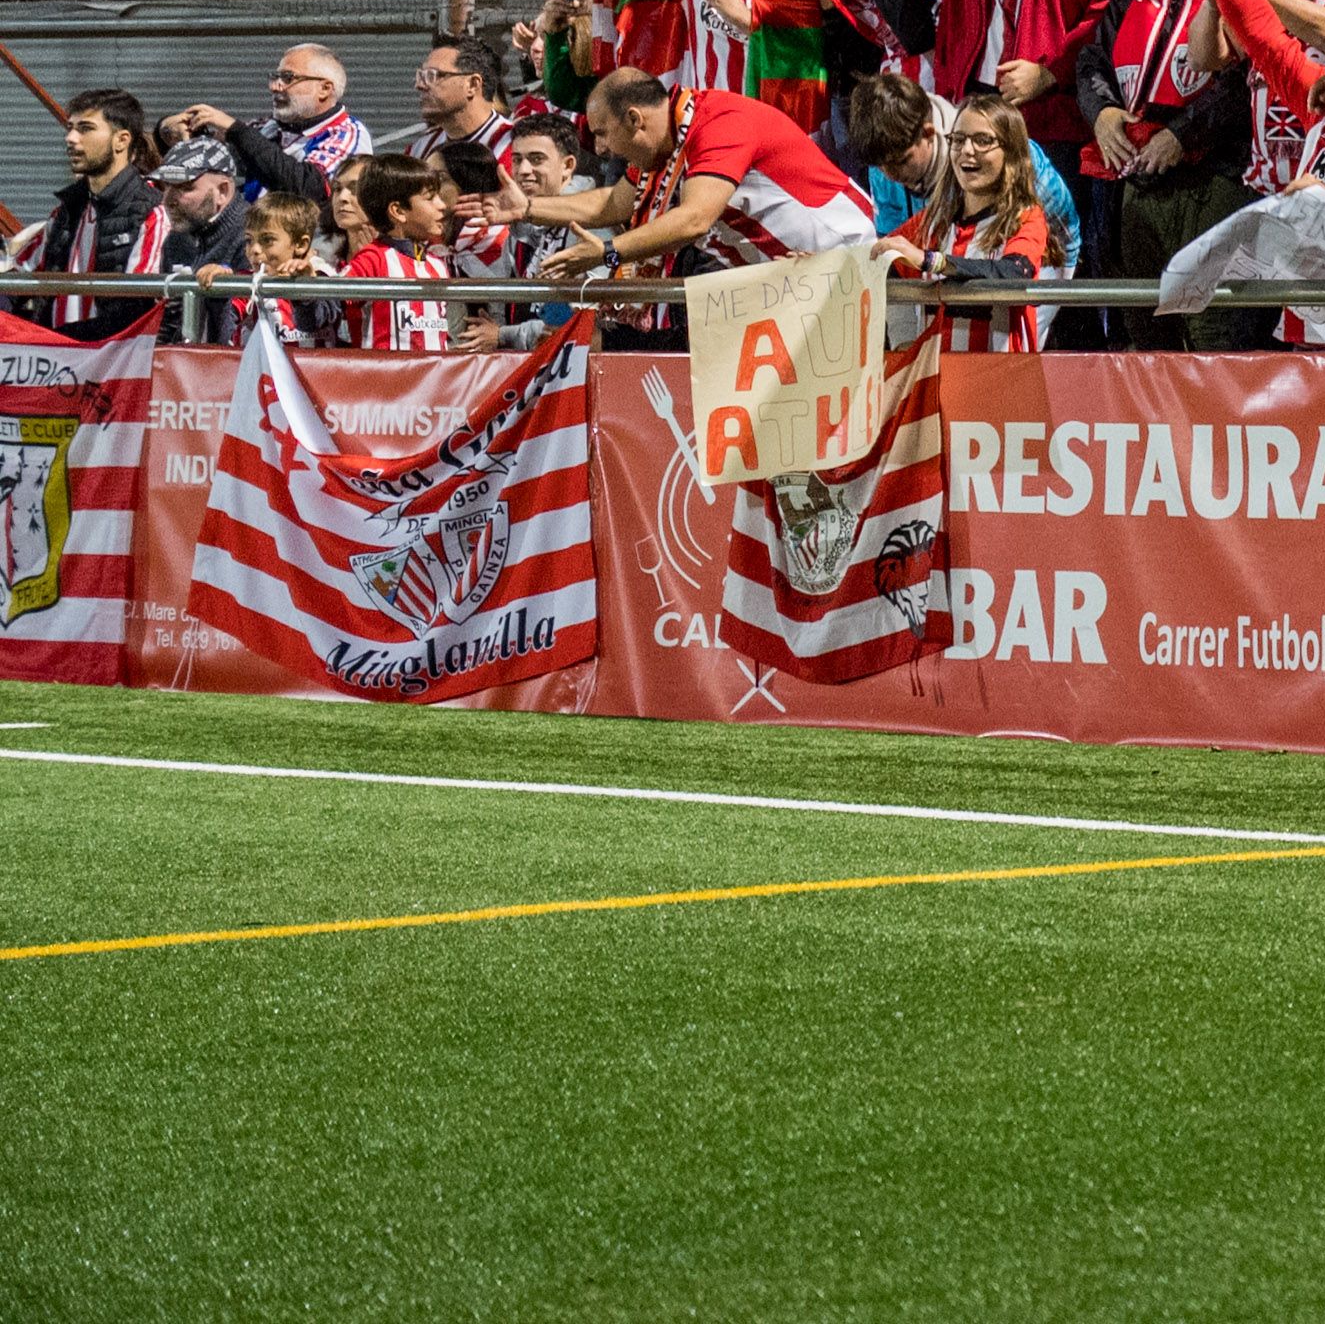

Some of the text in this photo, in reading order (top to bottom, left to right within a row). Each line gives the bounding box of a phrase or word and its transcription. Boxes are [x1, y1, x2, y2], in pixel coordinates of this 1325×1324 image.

[704, 287, 748, 327] ME
[763, 274, 815, 312] DAS
[149, 400, 231, 430] ERRET
[143, 602, 177, 622] Mare
[653, 611, 730, 650] CAL
[943, 568, 1109, 665] BAR
[155, 628, 178, 649] Tel.
[1138, 611, 1230, 667] Carrer
